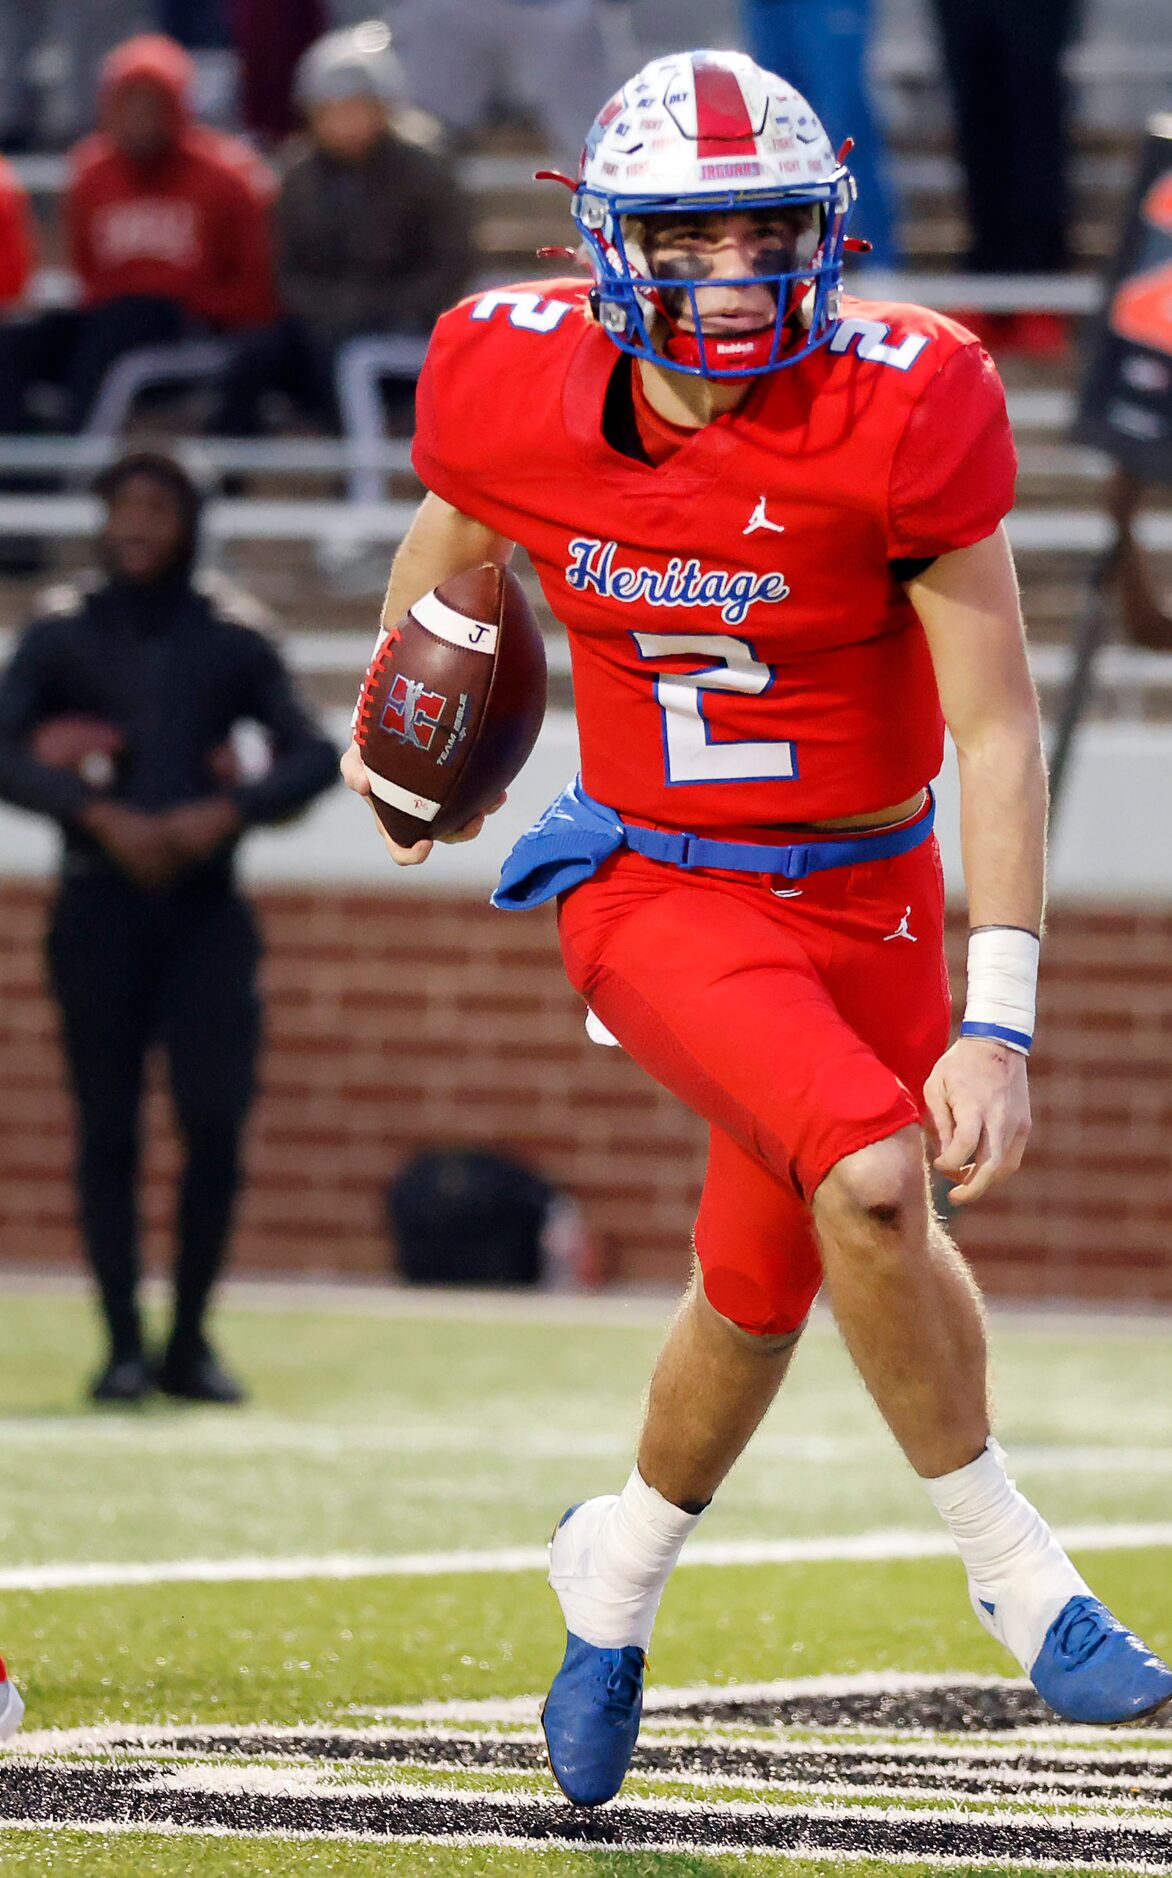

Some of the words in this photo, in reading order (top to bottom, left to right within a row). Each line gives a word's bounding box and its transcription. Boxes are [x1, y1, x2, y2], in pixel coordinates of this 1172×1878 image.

[469, 292, 574, 335] 2
[829, 318, 931, 372] 2
[565, 538, 791, 626] Heritage
[468, 624, 491, 643] J
[627, 634, 800, 787] 2
[436, 730, 457, 766] TEAM
